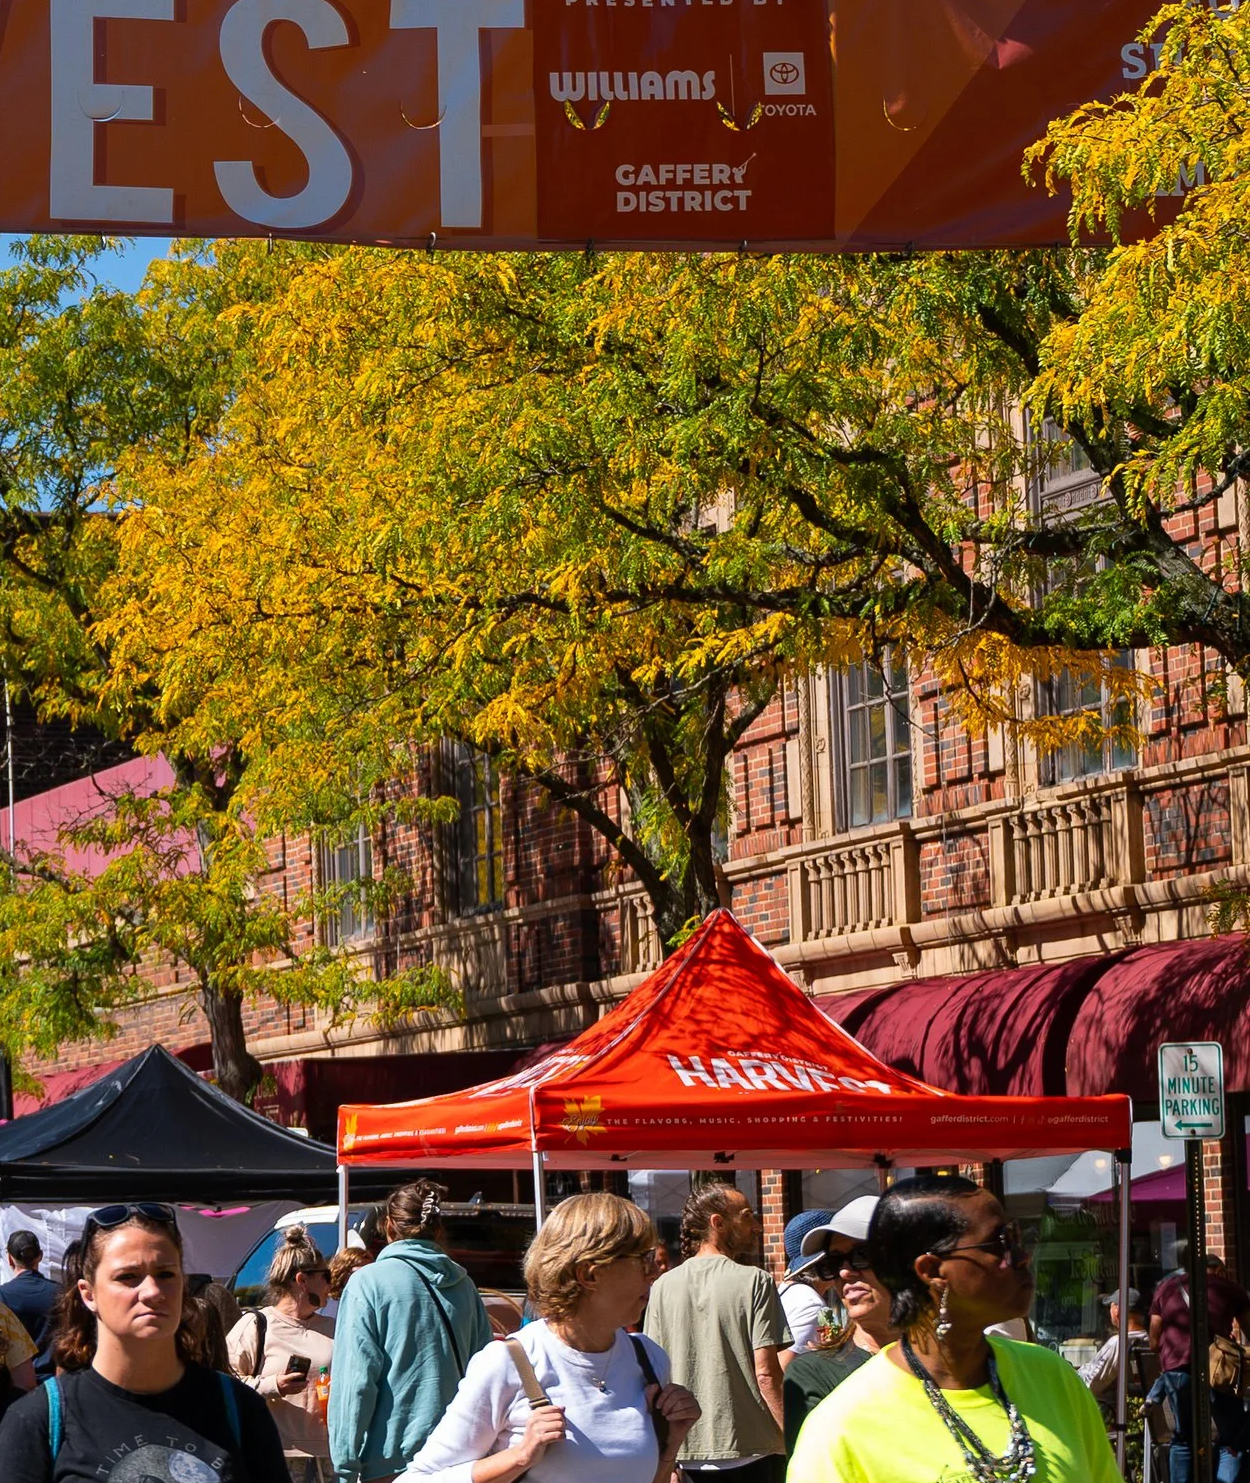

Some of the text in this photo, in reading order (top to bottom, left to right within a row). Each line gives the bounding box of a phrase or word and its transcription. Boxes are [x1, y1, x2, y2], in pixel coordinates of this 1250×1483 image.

[549, 69, 716, 103] WILLIAMS
[615, 163, 731, 186] GAFFER
[616, 189, 752, 213] DISTRICT
[1183, 1054, 1199, 1072] 15
[1167, 1076, 1216, 1095] MINUTE
[1165, 1098, 1220, 1116] PARKING
[634, 1118, 693, 1126] FLAVORS,
[699, 1117, 741, 1125] MUSIC,
[747, 1116, 807, 1124] SHOPPING
[825, 1115, 903, 1124] FESTIVITIES!
[930, 1114, 1009, 1125] gafferdistrict.com
[96, 1434, 149, 1475] TIME
[165, 1436, 197, 1453] TO
